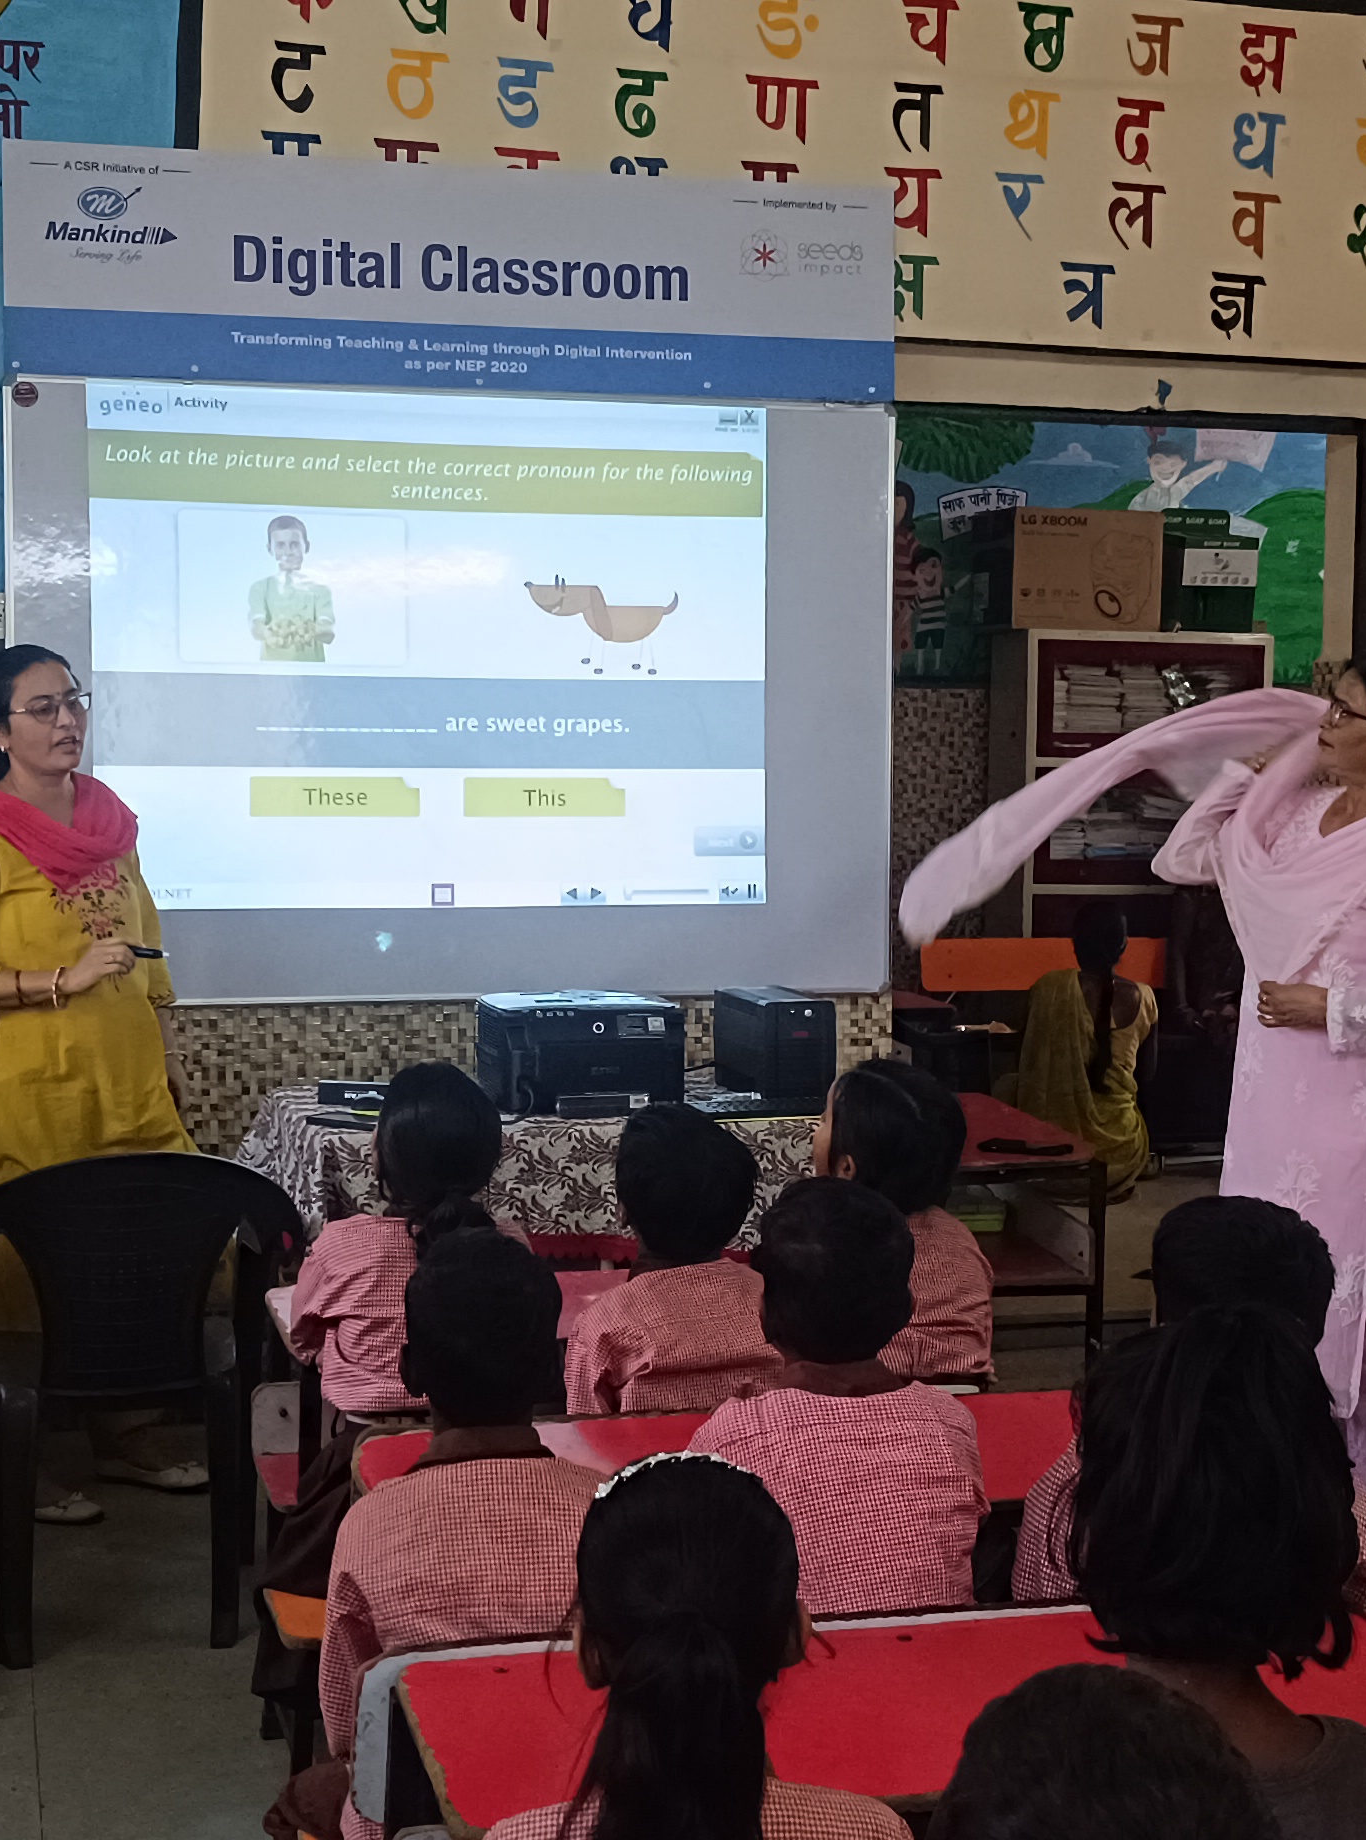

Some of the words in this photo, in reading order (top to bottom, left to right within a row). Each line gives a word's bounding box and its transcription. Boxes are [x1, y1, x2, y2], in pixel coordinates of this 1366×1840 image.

[903, 0, 960, 66] च
[1017, 1, 1073, 72] छ
[1126, 14, 1184, 76] ज
[1240, 22, 1297, 97] झ
[270, 40, 326, 113] ट
[386, 48, 450, 120] ठ
[496, 56, 555, 128] ड
[615, 67, 669, 138] ढ
[745, 74, 819, 145] ण
[892, 82, 944, 152] त
[1004, 89, 1060, 160] थ
[1115, 97, 1165, 172] द
[1233, 111, 1286, 178] ध
[64, 161, 72, 170] A
[74, 161, 100, 172] CSR
[103, 163, 145, 174] Initiative
[149, 165, 160, 175] of
[763, 198, 823, 211] Implemented
[826, 201, 837, 213] by
[884, 167, 942, 238] य
[995, 171, 1044, 241] र
[1108, 181, 1166, 249] ल
[1232, 191, 1281, 259] व
[45, 221, 149, 245] Mankind
[233, 234, 401, 296] Digital
[422, 244, 690, 302] Classroom
[798, 263, 862, 277] impact
[1060, 261, 1115, 330] त्र
[1210, 271, 1266, 341] ज्ञ
[231, 331, 332, 349] Transforming
[336, 335, 404, 352] Teaching
[408, 339, 419, 350] &
[424, 339, 488, 356] Learning
[493, 342, 550, 358] through
[554, 344, 601, 359] Digital
[605, 346, 693, 361] Intervention
[404, 360, 422, 370] as
[426, 360, 451, 373] per
[455, 359, 486, 372] NEP
[490, 361, 528, 373] 2020
[99, 396, 163, 415] geneo
[174, 396, 228, 412] Activity
[105, 444, 152, 463] Look
[160, 449, 180, 464] at
[188, 447, 219, 466] the
[225, 449, 295, 471] picture
[302, 453, 340, 471] and
[346, 455, 400, 475] select
[407, 457, 437, 476] the
[444, 461, 512, 478] correct
[517, 463, 595, 481] pronoun
[602, 463, 630, 483] for
[636, 464, 664, 482] the
[670, 464, 753, 486] following
[391, 482, 488, 501] sentences.
[942, 496, 965, 514] साफ
[968, 489, 991, 507] पानी
[1021, 515, 1037, 525] LG
[1042, 516, 1087, 526] XBOOM
[446, 718, 479, 732] are
[486, 716, 547, 733] sweet
[553, 717, 631, 737] grapes.
[302, 788, 368, 806] These
[523, 789, 566, 807] This
